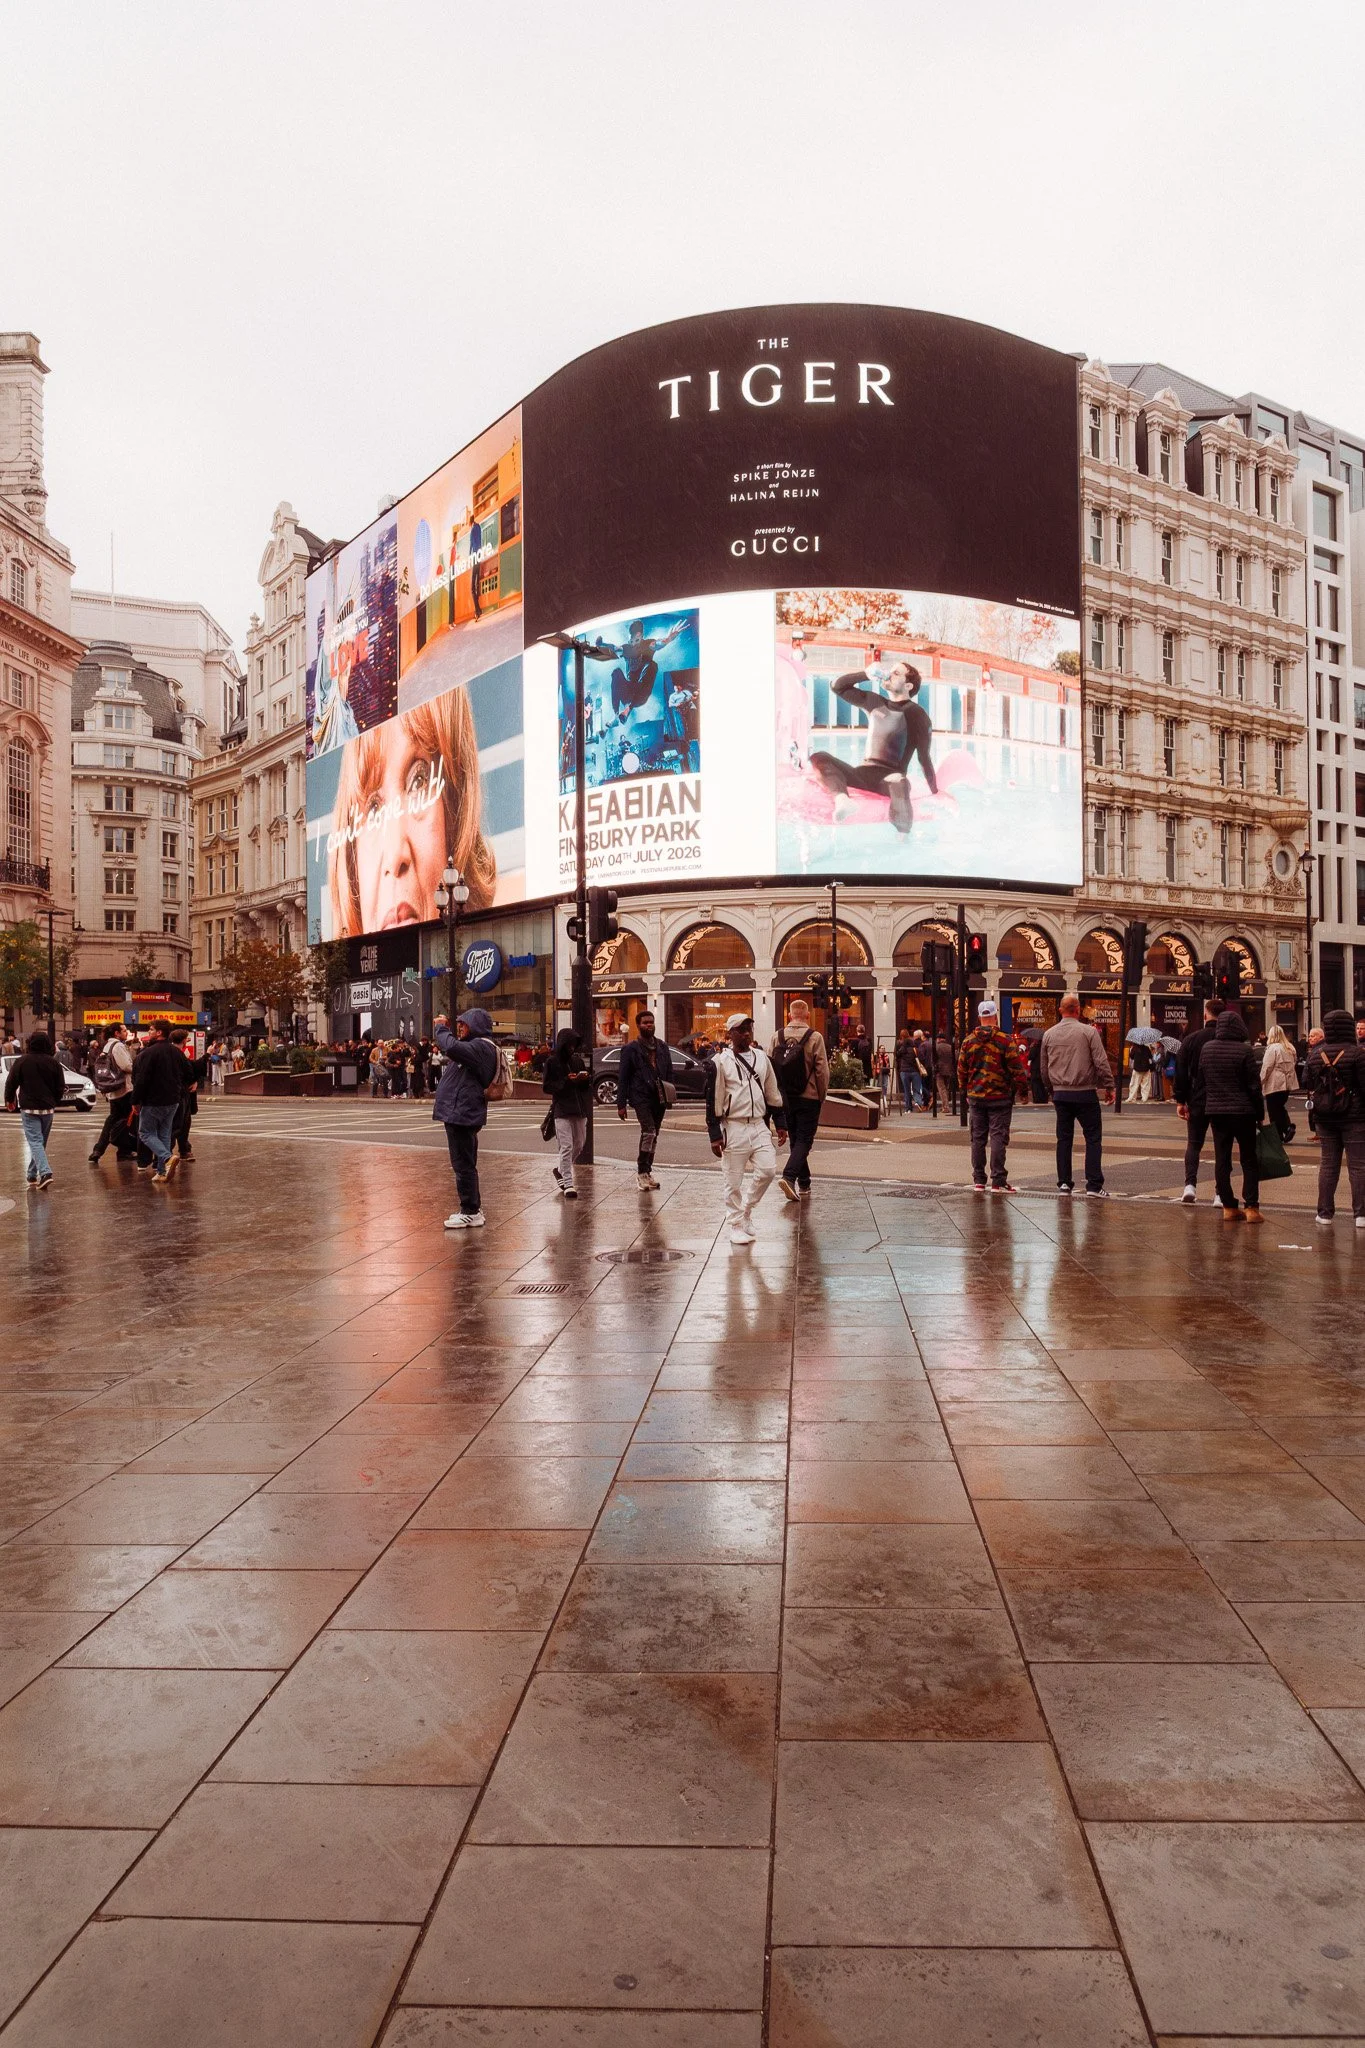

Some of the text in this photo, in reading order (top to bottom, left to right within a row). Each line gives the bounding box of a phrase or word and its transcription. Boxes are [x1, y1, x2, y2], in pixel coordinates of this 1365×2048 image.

[758, 337, 790, 349] THE
[658, 362, 895, 420] TIGER
[733, 468, 816, 483] SPIKE JONZE
[730, 488, 820, 502] HALINA REIJN
[754, 526, 796, 536] presented by
[730, 536, 820, 557] GUCCI
[420, 584, 430, 600] Do
[450, 558, 467, 581] Live
[18, 648, 30, 661] LIFE
[34, 656, 50, 672] OFFICE
[330, 628, 369, 680] LOVE
[315, 755, 445, 863] I can't cope with
[558, 780, 701, 833] KSABIAN
[641, 820, 701, 845] PARK
[559, 854, 605, 874] SATUDAY
[633, 849, 663, 864] JULY
[668, 846, 701, 860] 2026
[367, 945, 378, 959] THE
[360, 959, 378, 973] VENUE
[464, 948, 495, 985] Boots
[598, 981, 620, 992] Lindt
[688, 976, 720, 988] Lindt
[1019, 976, 1041, 988] Lindt
[1096, 979, 1117, 990] Lindt
[1166, 981, 1186, 992] Lindt
[352, 986, 393, 1000] oasis live '25
[1018, 1008, 1043, 1017] LINDOR
